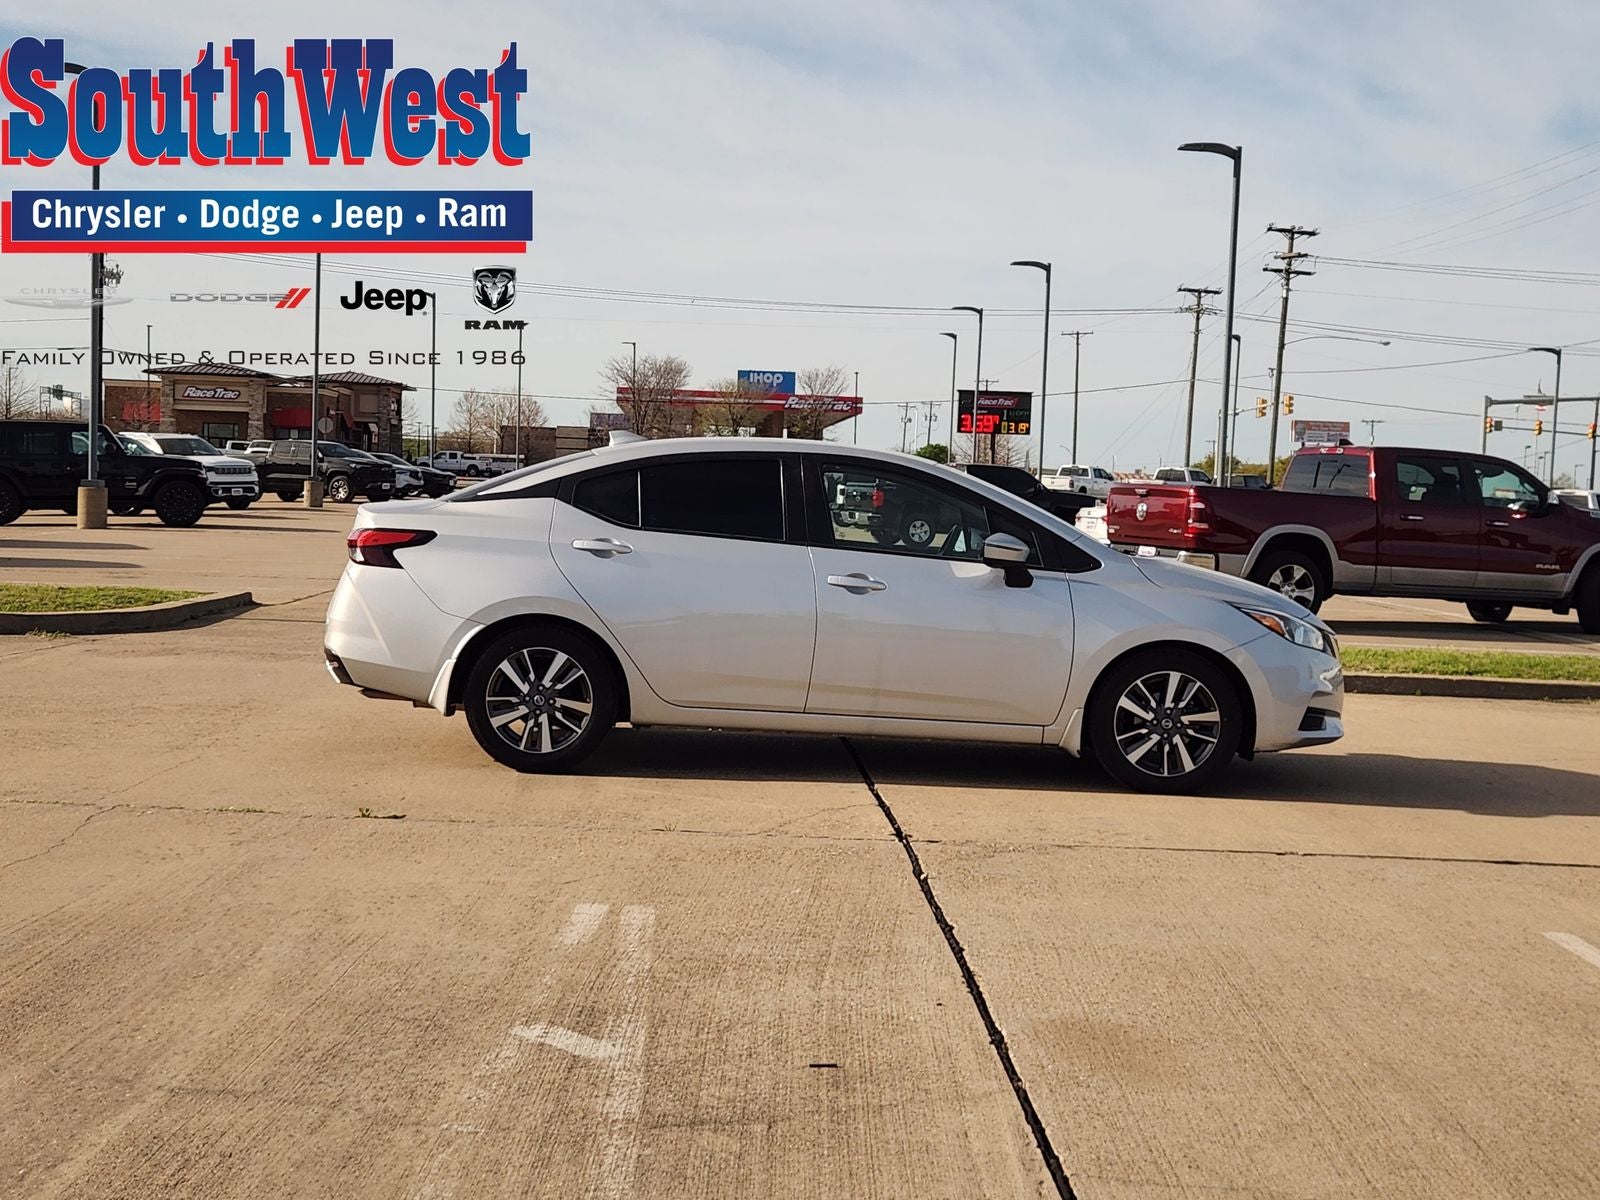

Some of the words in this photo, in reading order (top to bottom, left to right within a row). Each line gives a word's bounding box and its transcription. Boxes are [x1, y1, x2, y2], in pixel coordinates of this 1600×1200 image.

[749, 371, 784, 387] IHOP
[183, 386, 240, 399] RaceTrac
[977, 398, 1014, 406] RaceTrac
